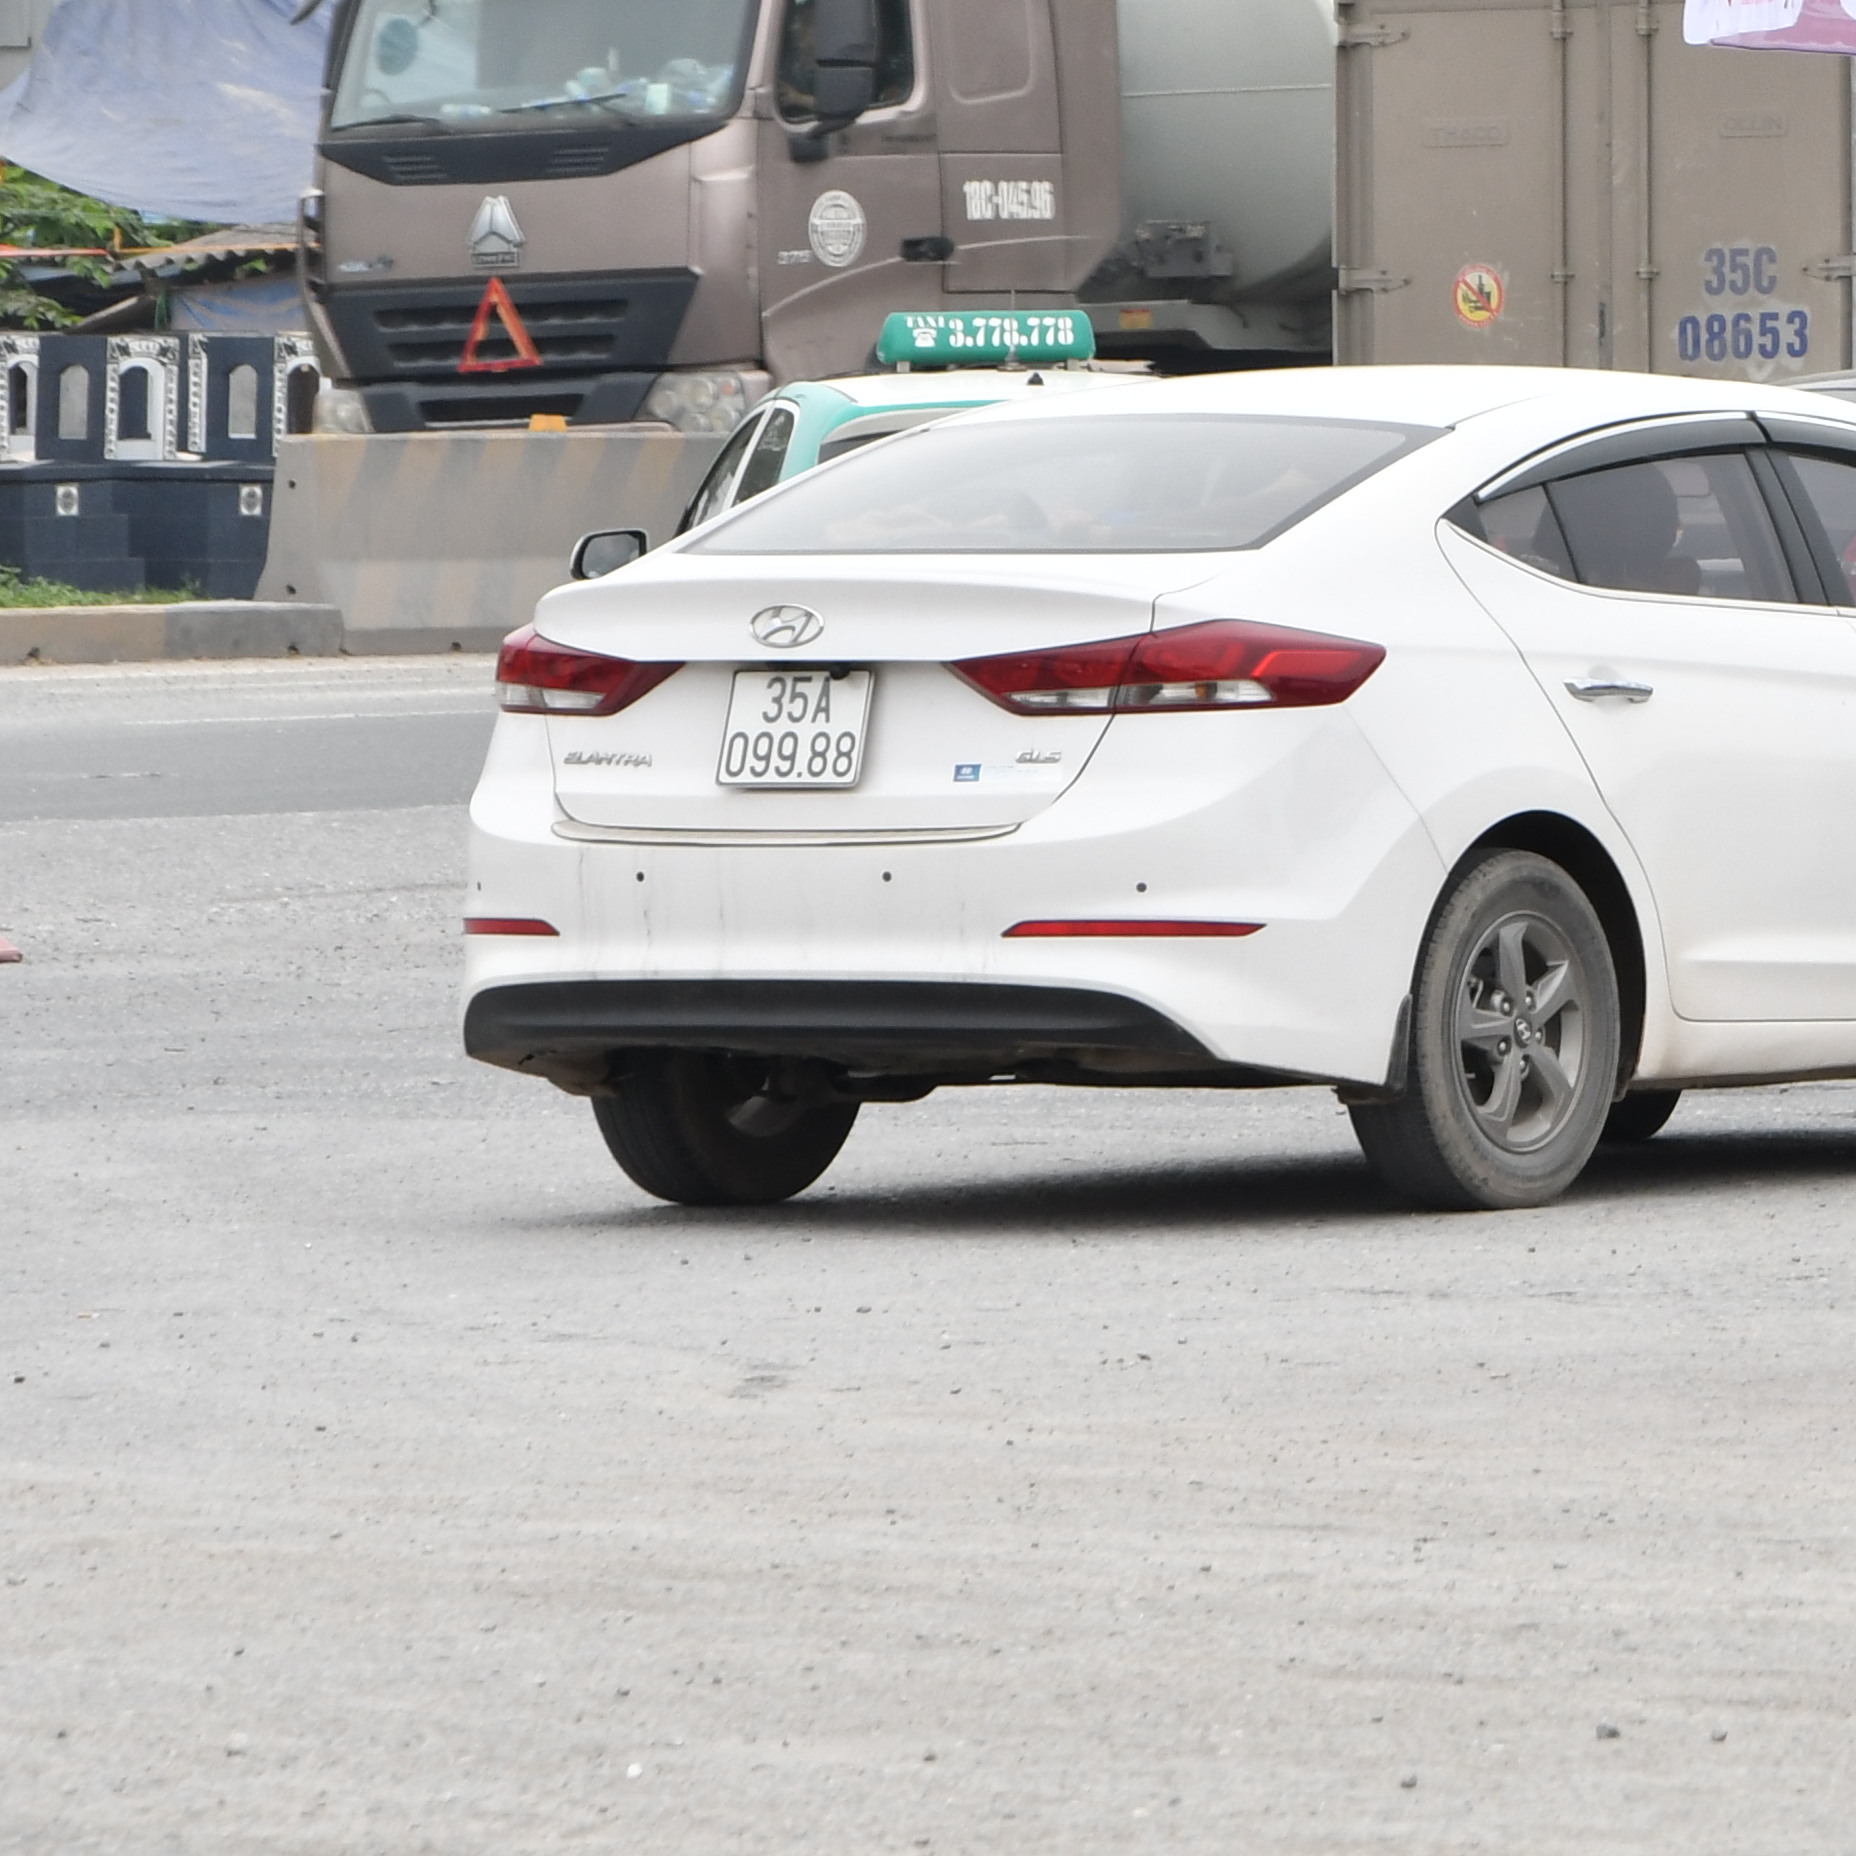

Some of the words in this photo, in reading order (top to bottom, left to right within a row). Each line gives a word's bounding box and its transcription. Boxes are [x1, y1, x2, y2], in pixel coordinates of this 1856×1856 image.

[1703, 246, 1777, 296] 35C
[905, 314, 945, 328] TAXI
[949, 316, 1075, 348] 3.778.778
[1678, 309, 1809, 362] 08653
[761, 675, 831, 724] 35A
[563, 750, 653, 768] ELANTRA
[724, 730, 856, 778] 099.88
